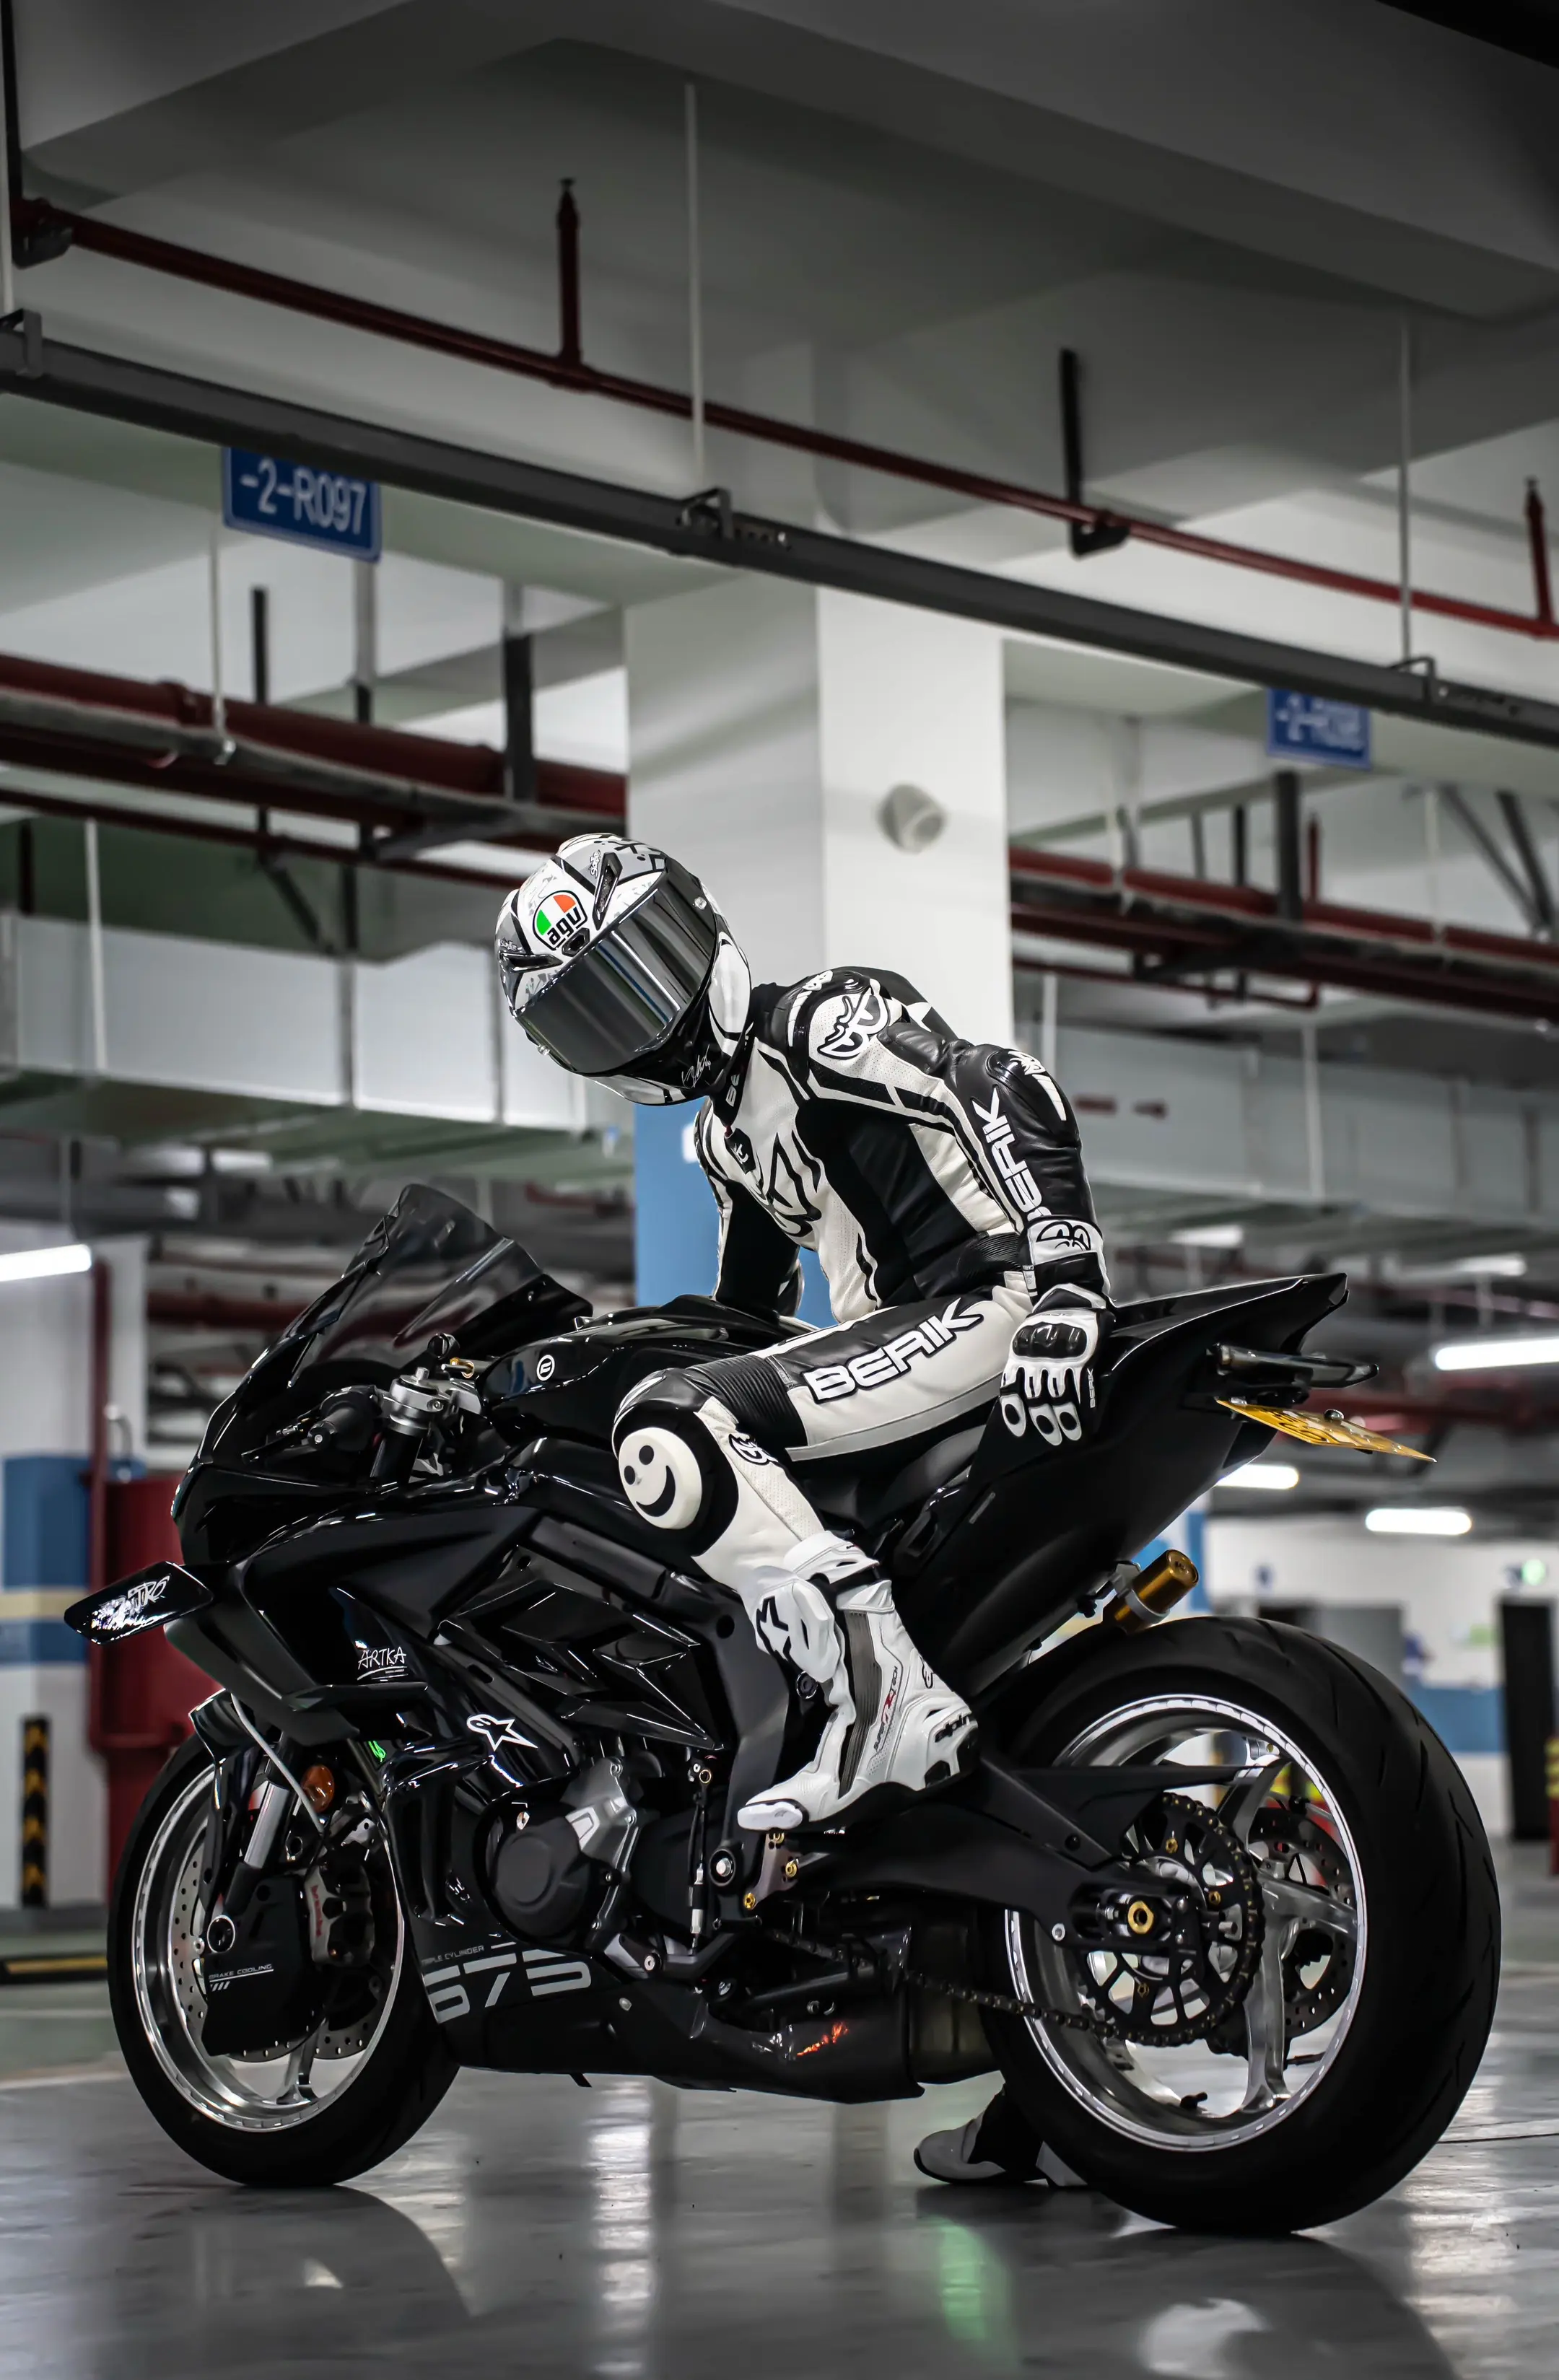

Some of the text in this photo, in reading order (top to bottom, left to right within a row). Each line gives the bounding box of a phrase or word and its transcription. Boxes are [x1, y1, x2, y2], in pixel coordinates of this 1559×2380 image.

[240, 457, 367, 535] -2-R097
[546, 906, 582, 945] agv
[801, 1297, 982, 1401] BERIK
[357, 1646, 407, 1670] ARTKA
[209, 1963, 272, 1980] BRAKE COOLING
[445, 1944, 485, 1960] CYLINDER
[422, 1948, 592, 2024] 675
